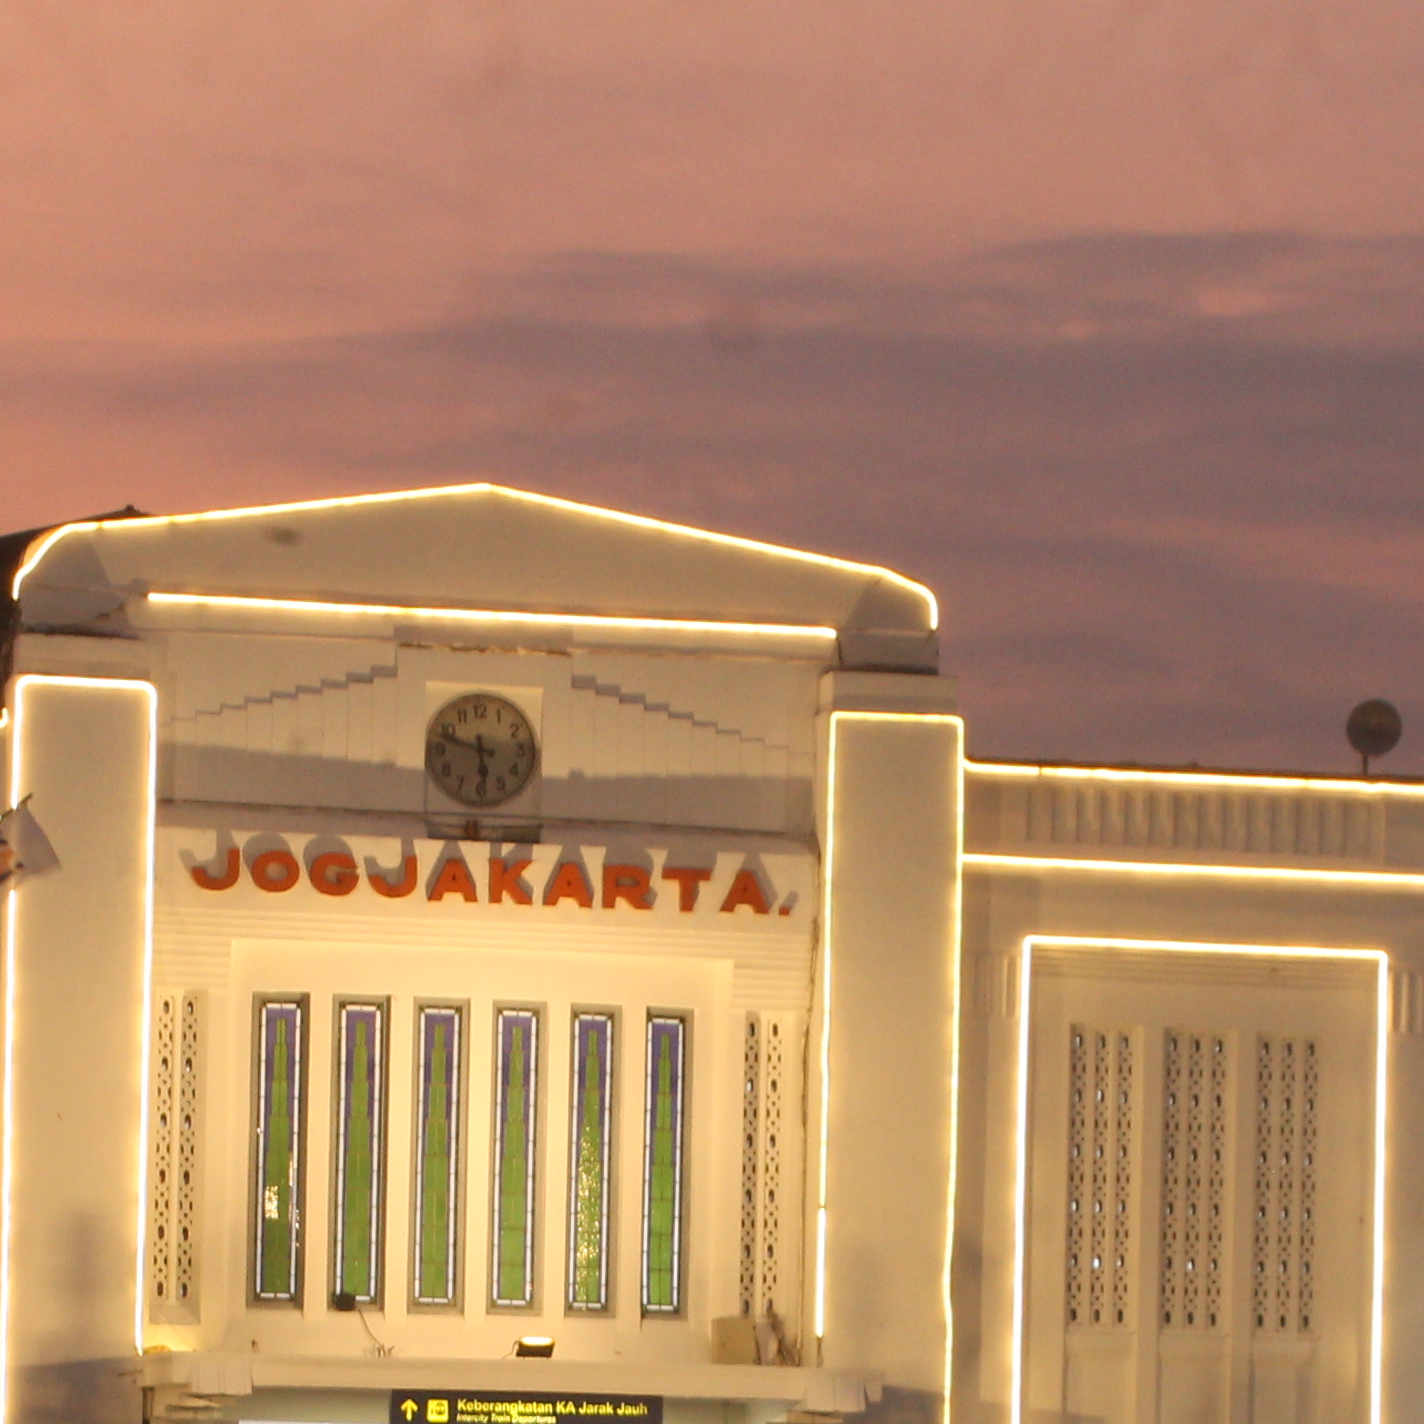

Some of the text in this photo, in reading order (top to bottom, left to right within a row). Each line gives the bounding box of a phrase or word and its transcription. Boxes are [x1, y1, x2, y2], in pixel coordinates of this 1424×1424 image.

[457, 1398, 649, 1416] Keberangkatan KA Jarak Jauh
